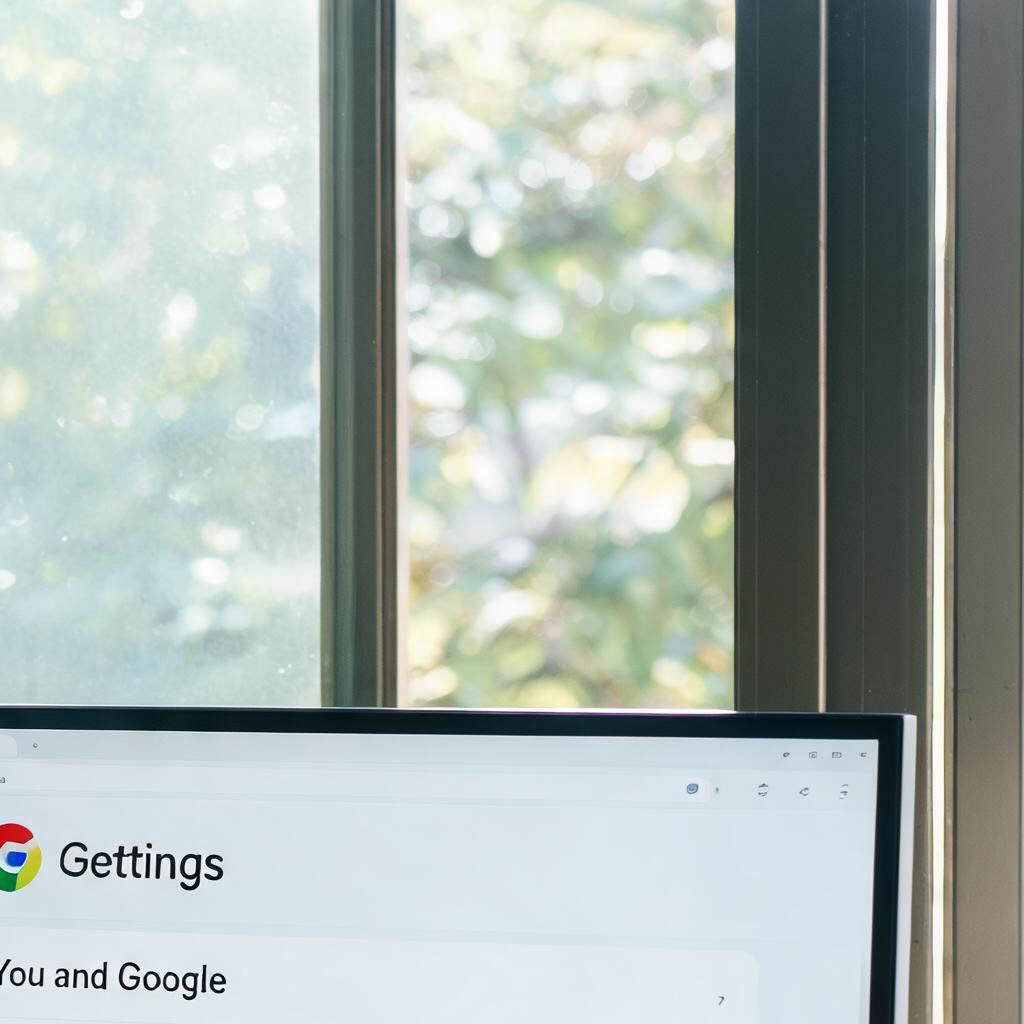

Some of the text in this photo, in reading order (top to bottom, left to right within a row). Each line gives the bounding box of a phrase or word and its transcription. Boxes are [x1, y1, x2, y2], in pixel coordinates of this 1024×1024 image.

[60, 842, 224, 892] Gettings
[55, 962, 108, 990] and
[118, 962, 227, 1000] Google
